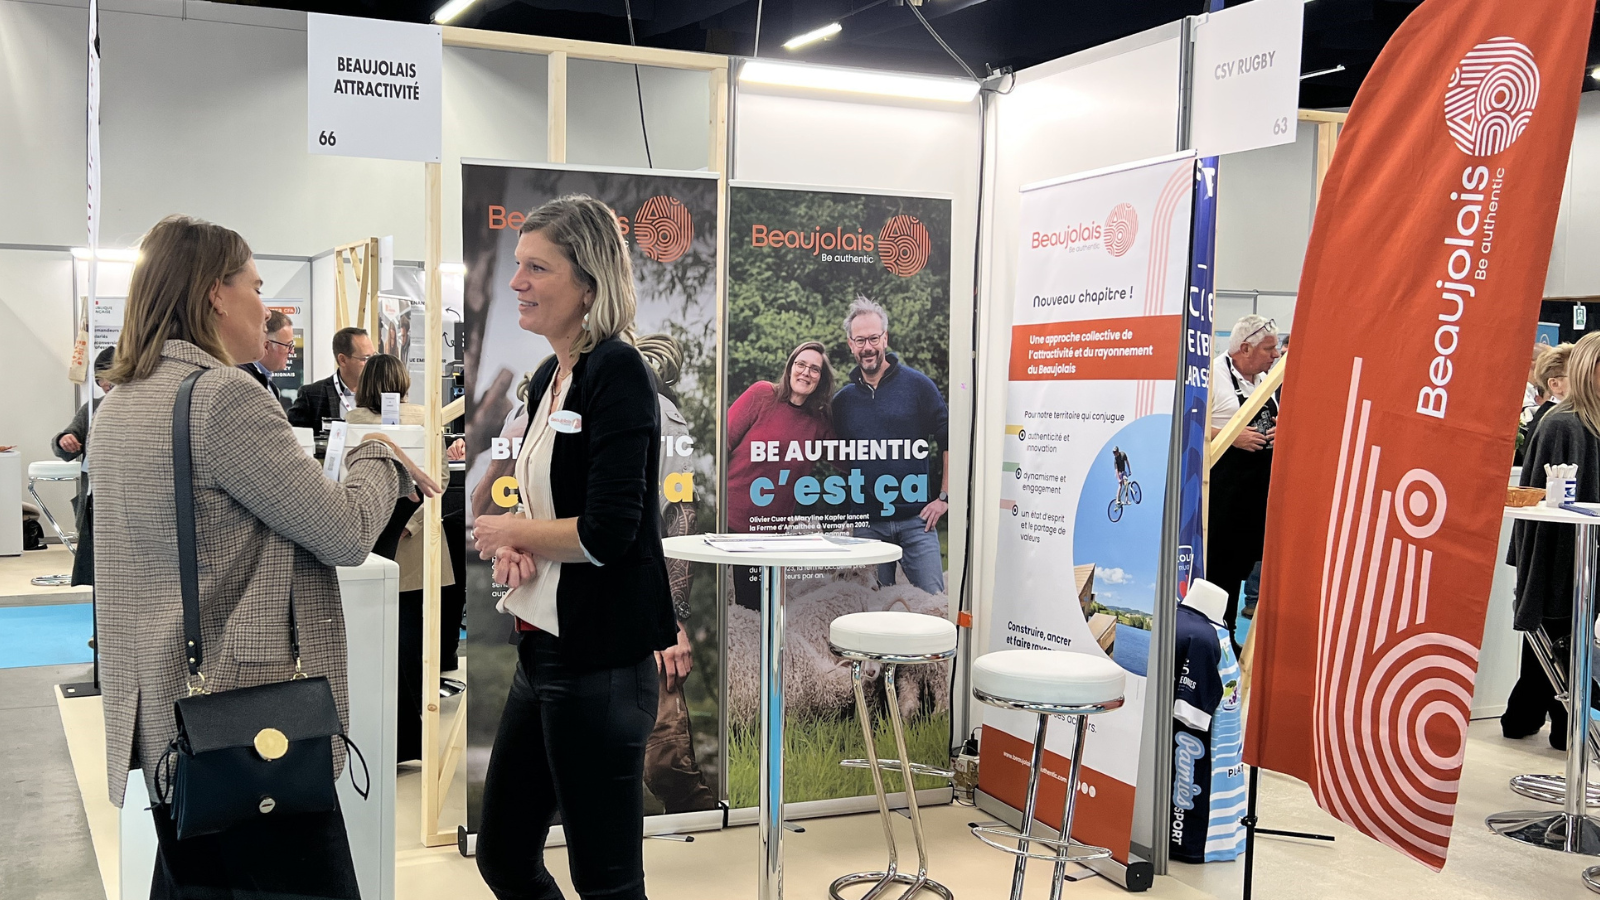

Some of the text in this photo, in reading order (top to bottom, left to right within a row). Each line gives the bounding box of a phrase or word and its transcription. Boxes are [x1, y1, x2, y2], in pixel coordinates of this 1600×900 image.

[336, 56, 417, 79] BEAUJOLAIS
[1214, 50, 1276, 81] CSV RUGBY
[333, 78, 420, 101] ATTRACTIVITÉ
[1272, 116, 1288, 136] 63
[318, 130, 337, 147] 66
[1474, 167, 1506, 280] Be authentic
[752, 224, 875, 256] Beaujolais
[1031, 220, 1102, 249] Beaujolais
[1076, 243, 1100, 253] authentic
[821, 252, 874, 264] Be authentic
[1033, 286, 1134, 308] Nouveau chapitre !
[1416, 165, 1490, 418] Beaujolais
[1030, 329, 1133, 348] Une approche collective de
[1028, 344, 1153, 360] l'attractivité et du rayonnement
[1028, 364, 1076, 376] du Beaujolais
[1024, 410, 1124, 424] Pour notre territoire qui conjugue
[1028, 432, 1070, 442] authenticité et
[750, 439, 929, 462] BE AUTHENTIC
[1027, 444, 1058, 453] innovation
[1024, 472, 1058, 484] dynamisme
[750, 468, 928, 516] c'est ça
[1022, 484, 1061, 494] engagement
[794, 514, 824, 524] Maryline
[824, 514, 845, 522] Kapfer
[1031, 510, 1042, 520] état
[1042, 512, 1064, 524] d'esprit
[822, 522, 846, 530] Vernay
[1021, 522, 1066, 536] et le partage de
[1020, 533, 1040, 544] valeurs
[1007, 620, 1072, 647] Construire, ancrer
[1006, 636, 1014, 645] et
[1014, 636, 1031, 650] faire
[1172, 806, 1184, 845] SPORT
